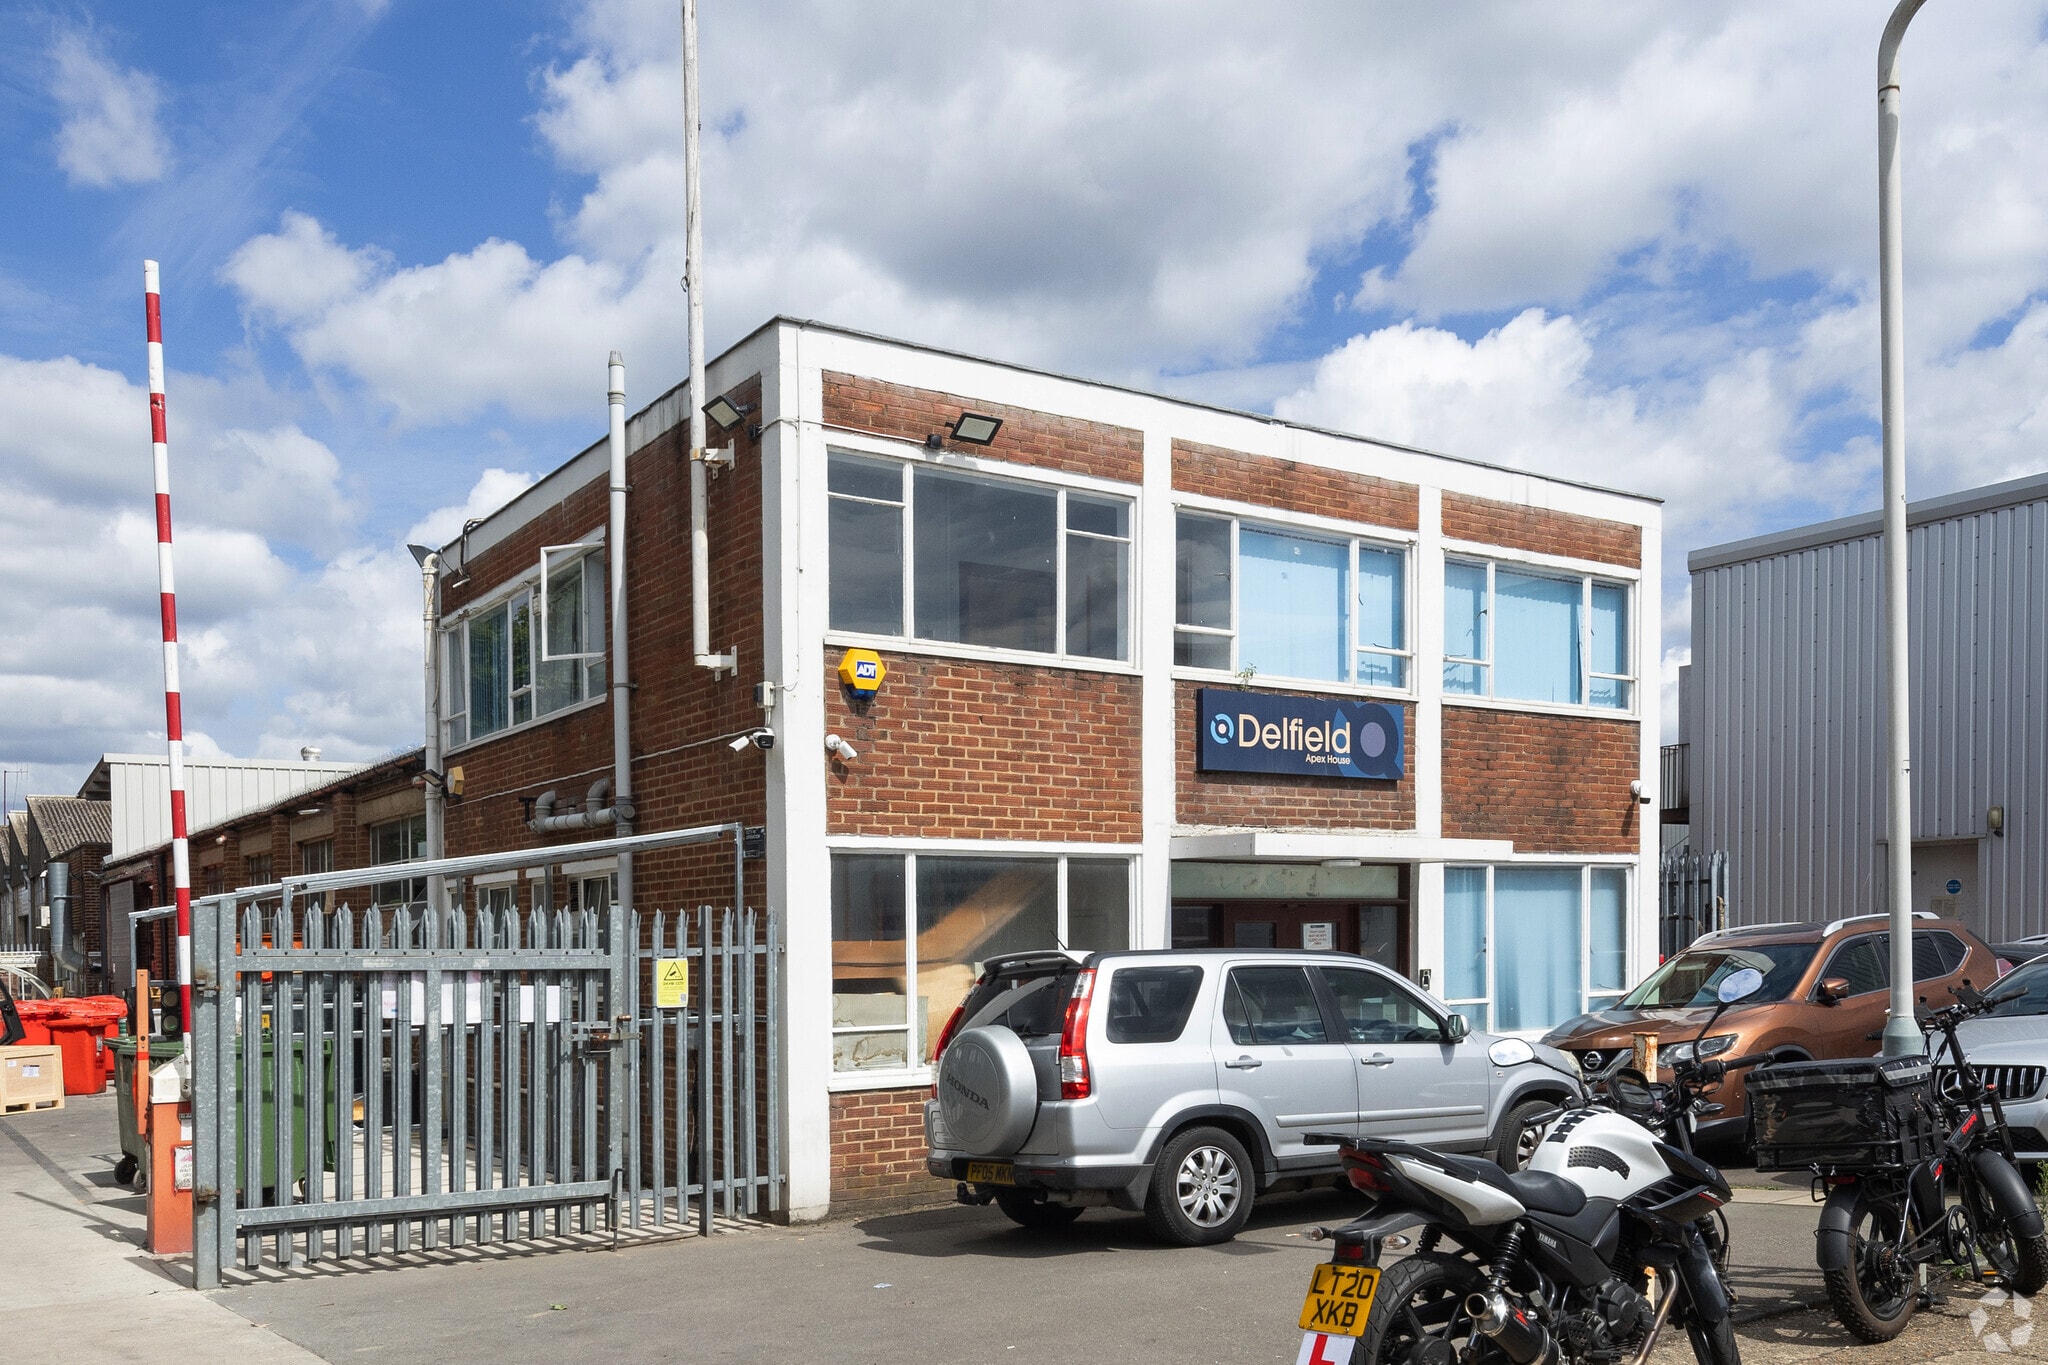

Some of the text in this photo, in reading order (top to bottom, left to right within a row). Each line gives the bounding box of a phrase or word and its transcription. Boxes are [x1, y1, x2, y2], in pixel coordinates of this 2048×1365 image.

[857, 664, 876, 677] ADT
[1238, 713, 1351, 754] Delfield
[1305, 753, 1351, 765] Apex House
[946, 1072, 990, 1110] HONDA
[971, 1164, 994, 1180] PF05
[1312, 1269, 1375, 1299] LT20
[1310, 1298, 1359, 1328] XKB
[1308, 1333, 1335, 1365] L
